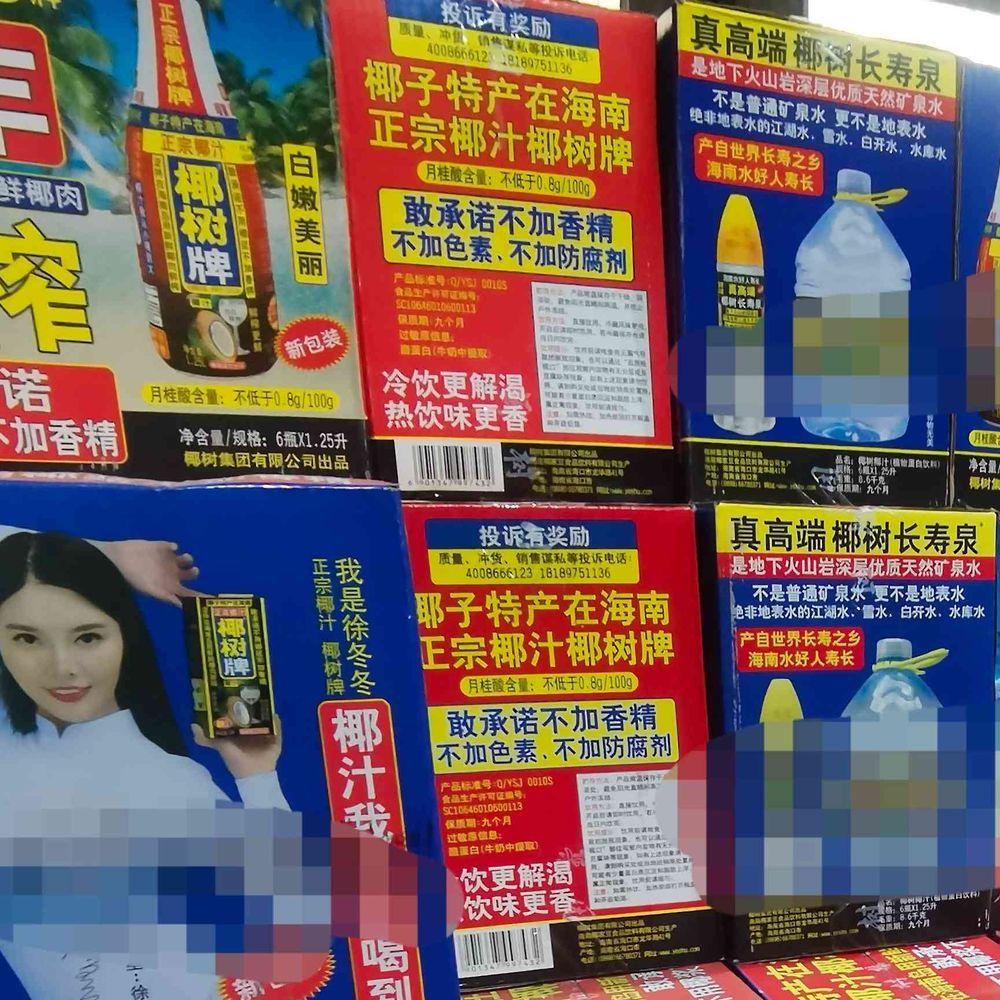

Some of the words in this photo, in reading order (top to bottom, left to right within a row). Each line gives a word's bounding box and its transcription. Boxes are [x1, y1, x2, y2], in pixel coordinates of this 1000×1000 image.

[441, 1, 551, 38] 投诉有奖励
[364, 60, 630, 132] 椰子特产在海南
[691, 56, 943, 116] 是地下火山岩深层优质天然矿泉水
[369, 107, 633, 175] 正宗椰汁椰树牌
[698, 137, 820, 169] 产自世界长寿之乡
[707, 161, 813, 192] 海南水好人寿长
[175, 162, 236, 285] 椰树牌
[288, 148, 324, 277] 白嫩美丽
[404, 195, 612, 244] 敢承诺不加香精
[284, 330, 344, 360] 新包装
[382, 368, 526, 402] 冷饮更解渴
[384, 399, 528, 432] 热饮味更香
[0, 416, 119, 457] 加香精
[184, 451, 349, 471] 椰树集团有限公司出品
[479, 524, 590, 549] 投诉有奖励
[466, 567, 533, 580] 4008666123
[540, 566, 611, 579] 18189751136
[730, 557, 981, 578] 是地下火山岩深层优质天然矿泉水
[752, 584, 864, 603] 不是普通矿泉水
[874, 584, 965, 603] 更不是地表水
[335, 557, 376, 696] 我是徐冬冬
[740, 630, 861, 648] 产自世界长寿之乡
[218, 618, 254, 677] 椰树牌
[420, 631, 675, 671] 正宗椰汁椰树牌
[748, 650, 855, 667] 海南水好人寿长
[447, 703, 657, 738] 敢承诺不加香精
